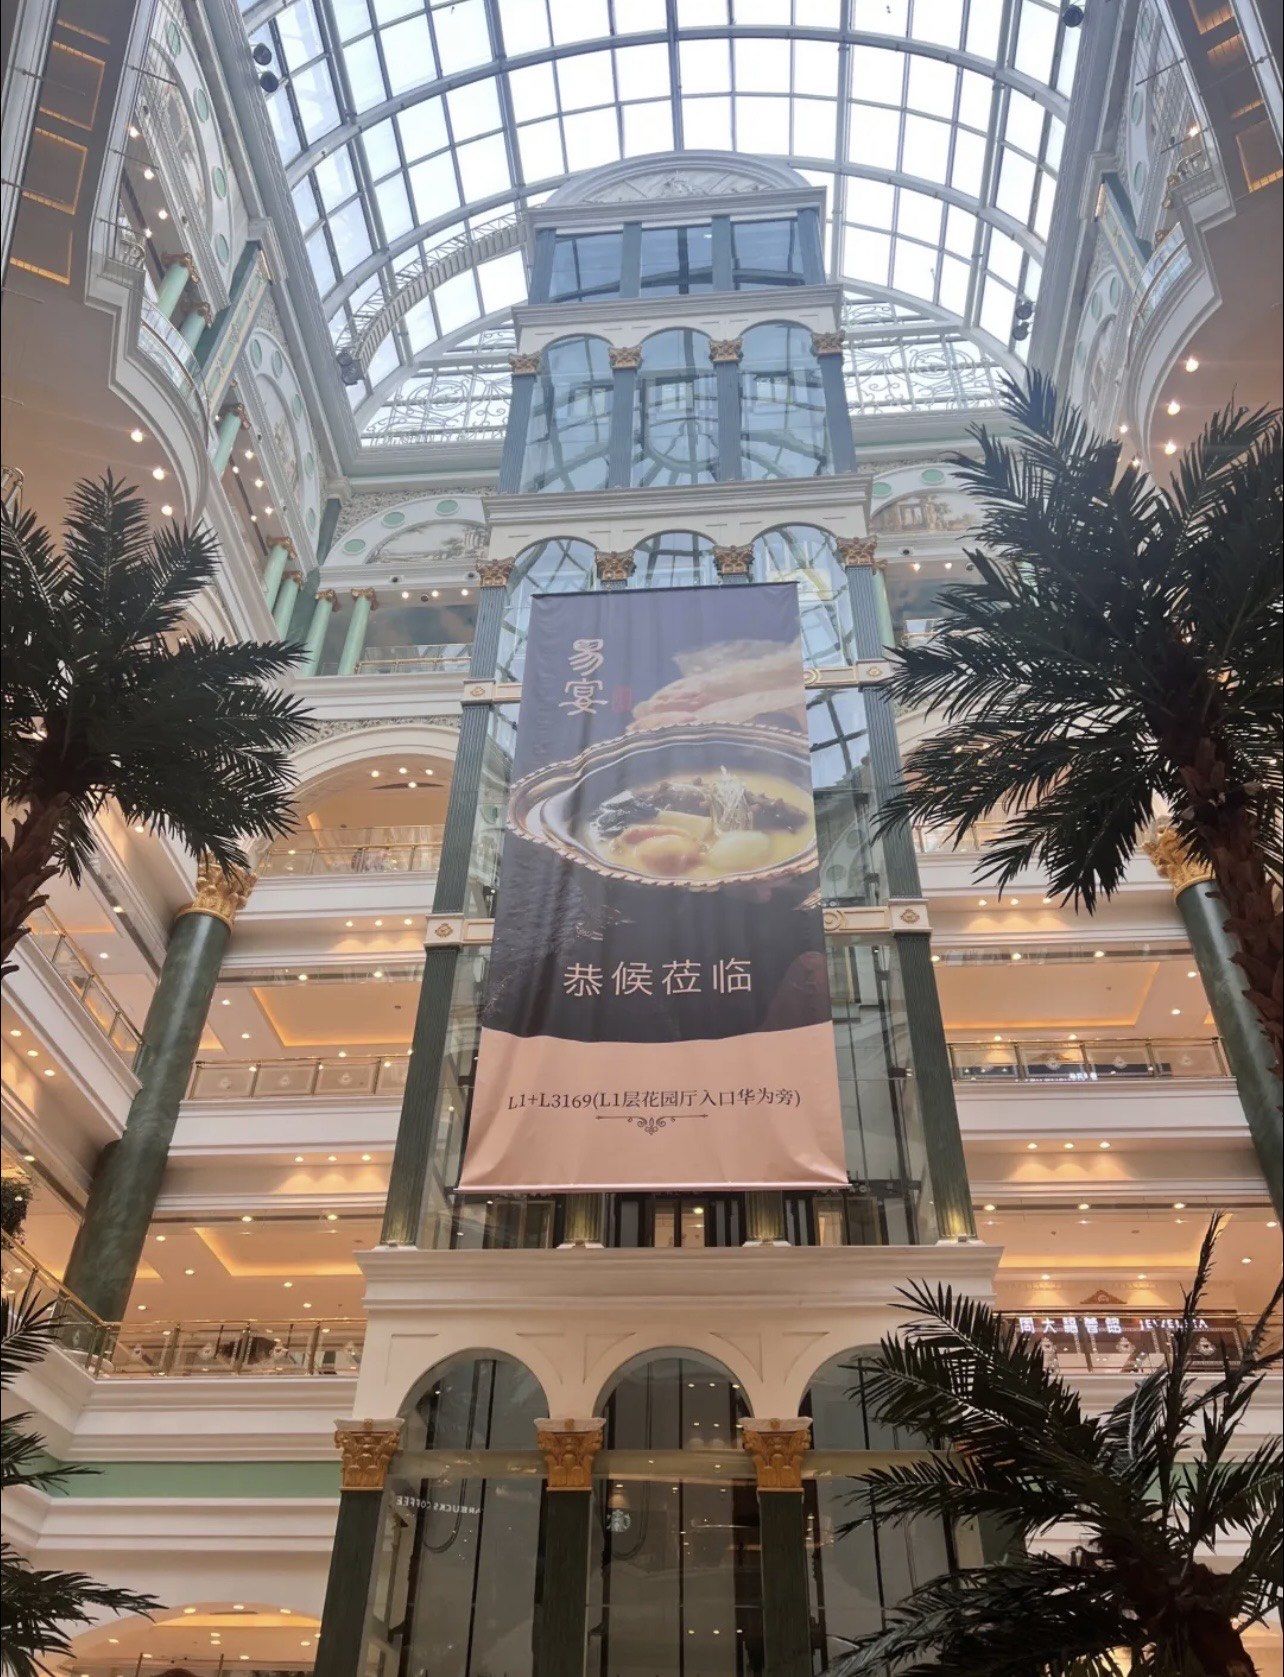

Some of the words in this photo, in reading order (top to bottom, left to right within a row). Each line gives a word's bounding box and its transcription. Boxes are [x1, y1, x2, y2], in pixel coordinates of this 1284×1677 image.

[559, 638, 608, 715] 易宴
[563, 957, 752, 997] 恭候莅临
[508, 1087, 801, 1110] L1+L3169(L1层花园厅入口华为旁)
